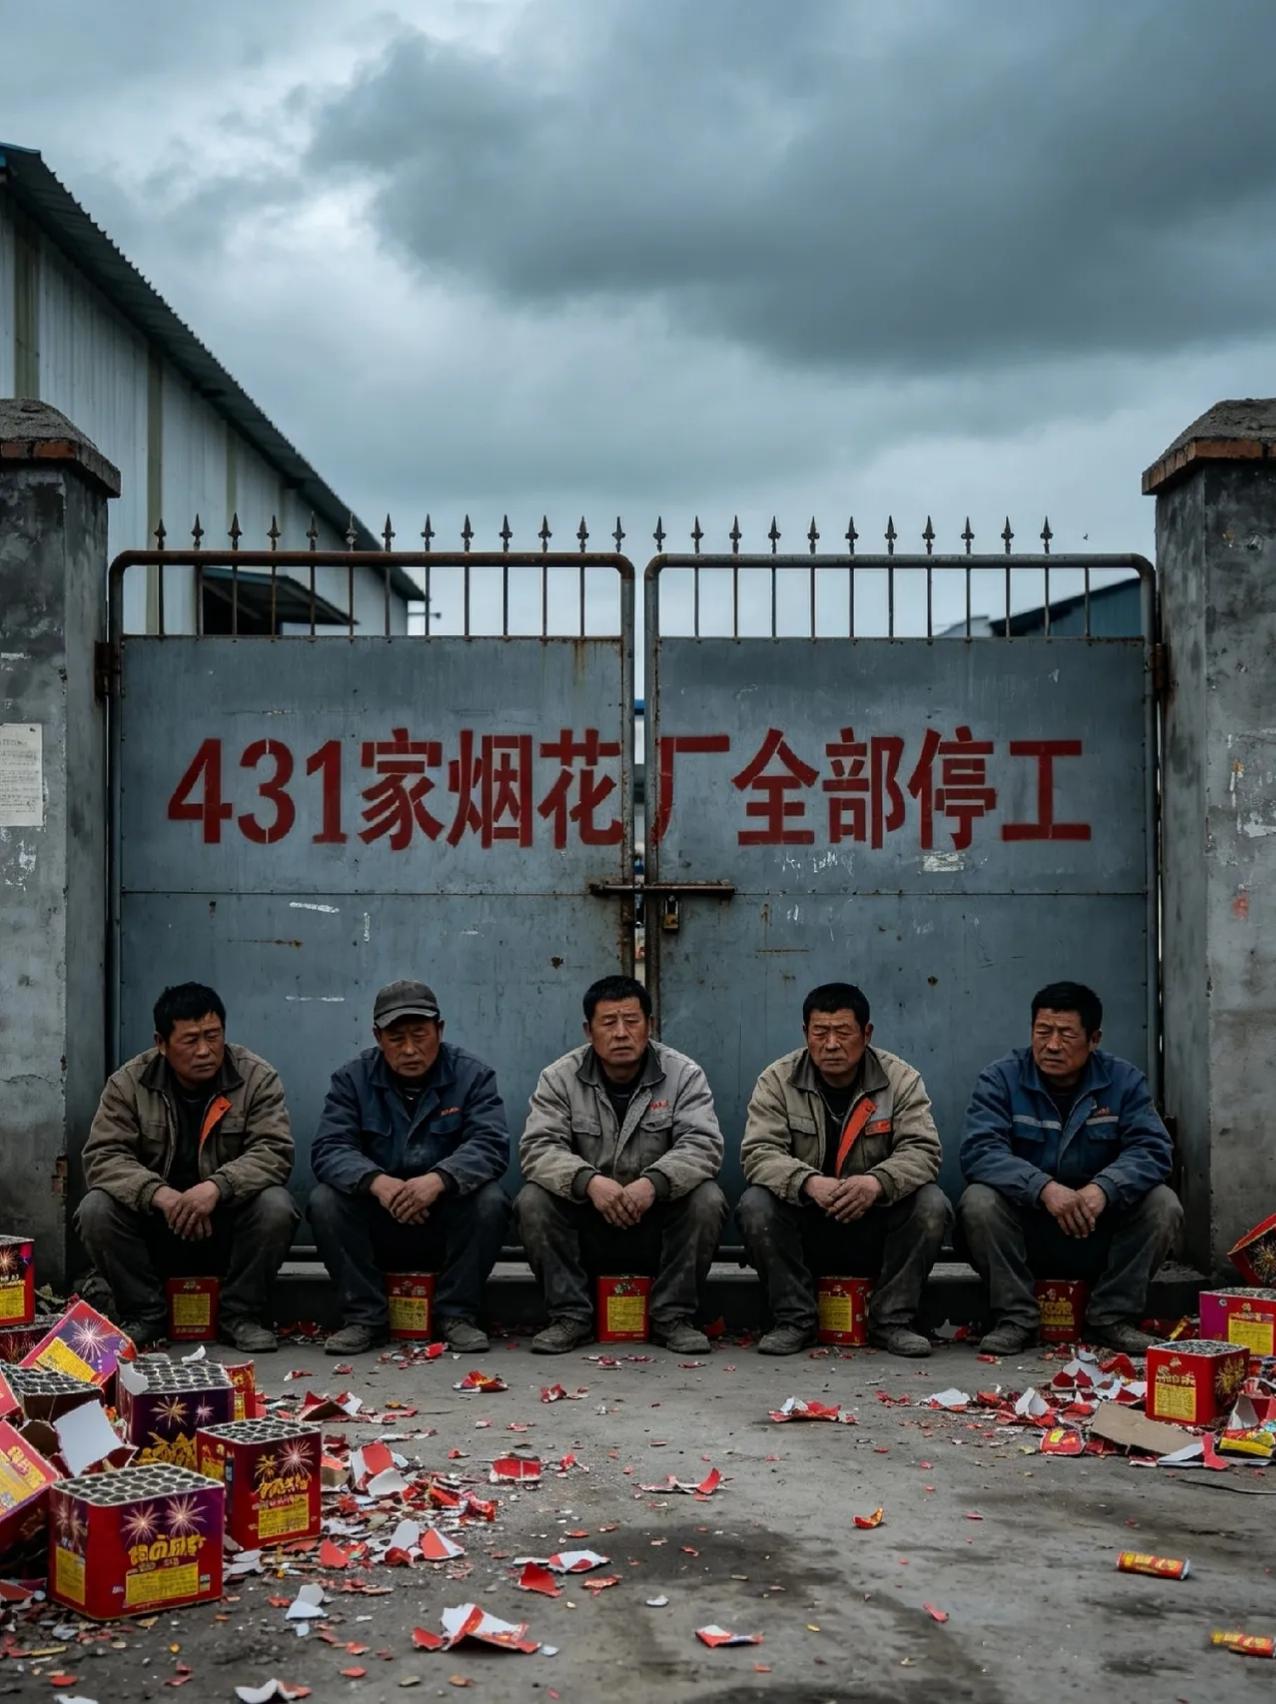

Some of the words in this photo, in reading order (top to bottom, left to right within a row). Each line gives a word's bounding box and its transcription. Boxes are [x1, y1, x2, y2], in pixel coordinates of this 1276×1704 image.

[167, 726, 1091, 850] 431家烟花厂全部停工
